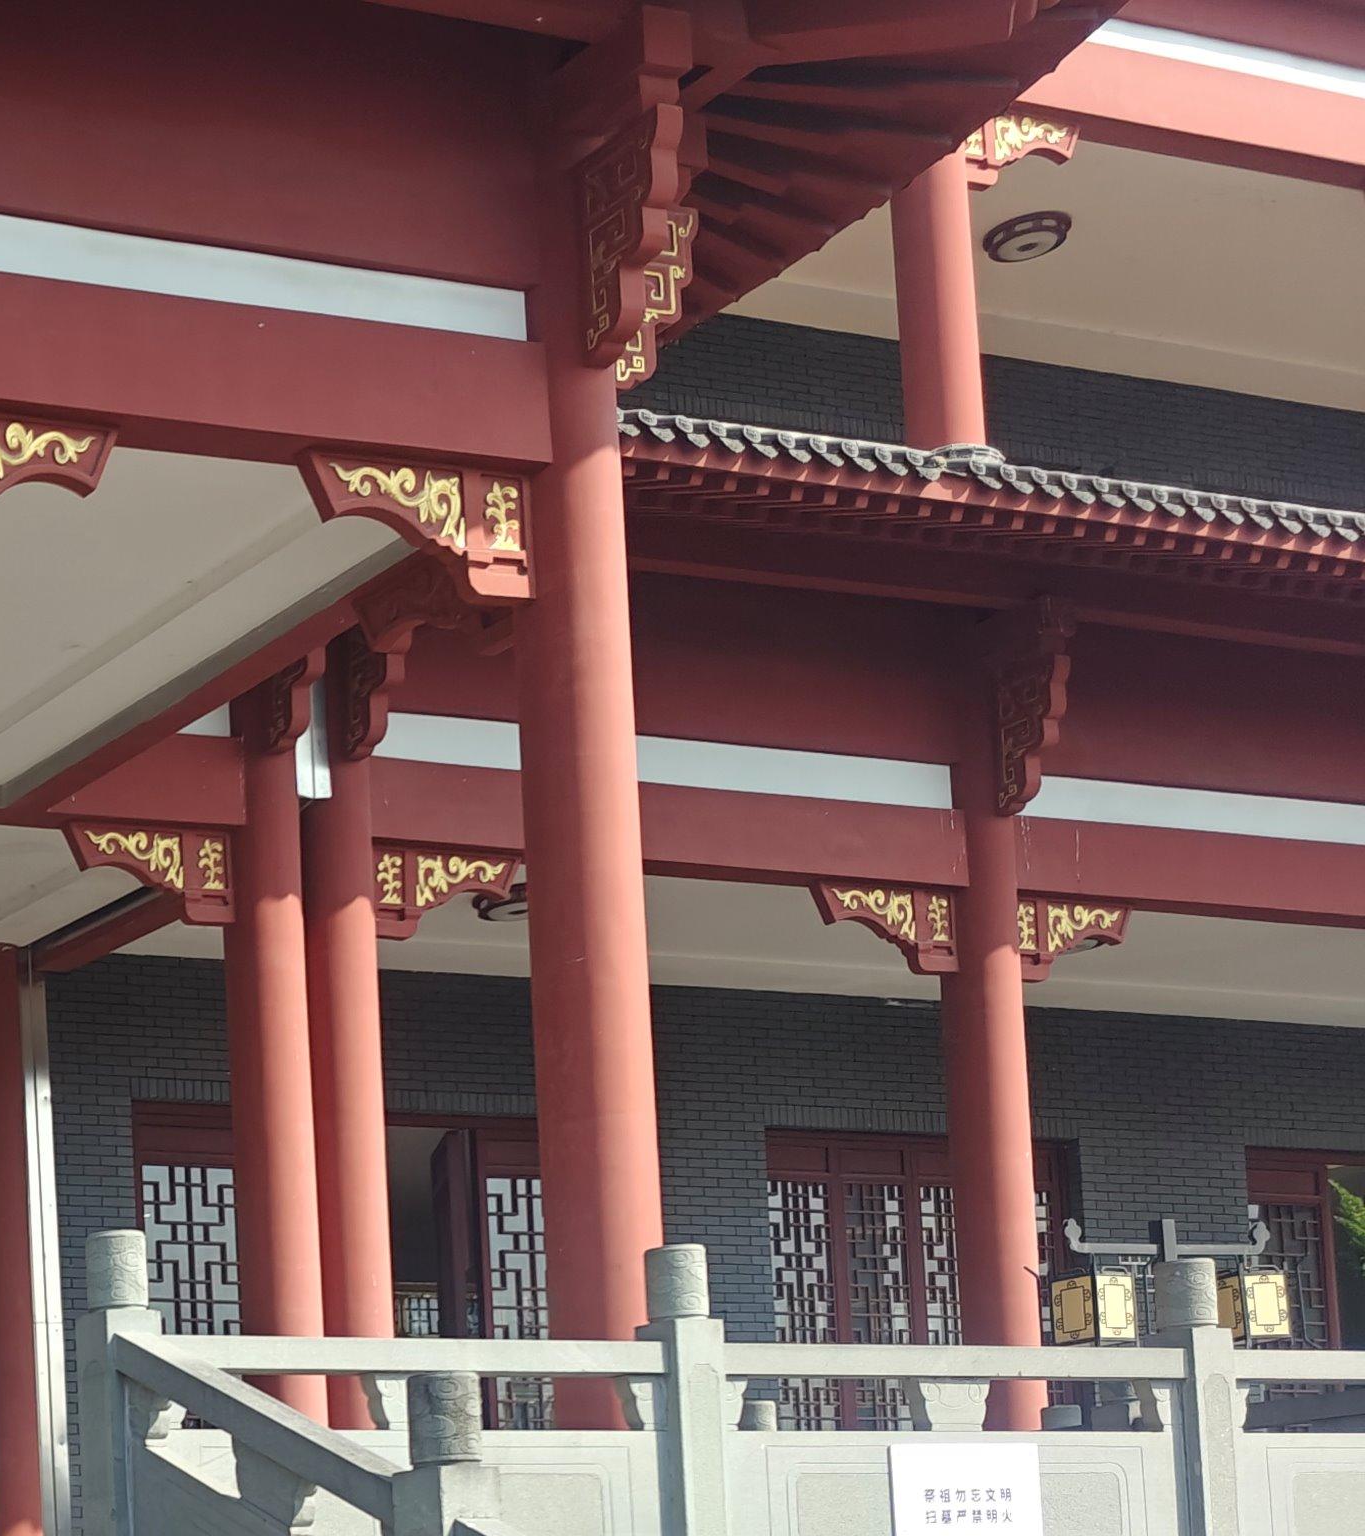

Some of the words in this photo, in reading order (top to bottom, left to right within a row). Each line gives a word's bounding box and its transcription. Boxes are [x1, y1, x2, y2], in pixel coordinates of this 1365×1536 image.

[924, 1487, 1011, 1502] 祭祖勿忘文明
[926, 1509, 1012, 1524] 扫墓严禁明火
